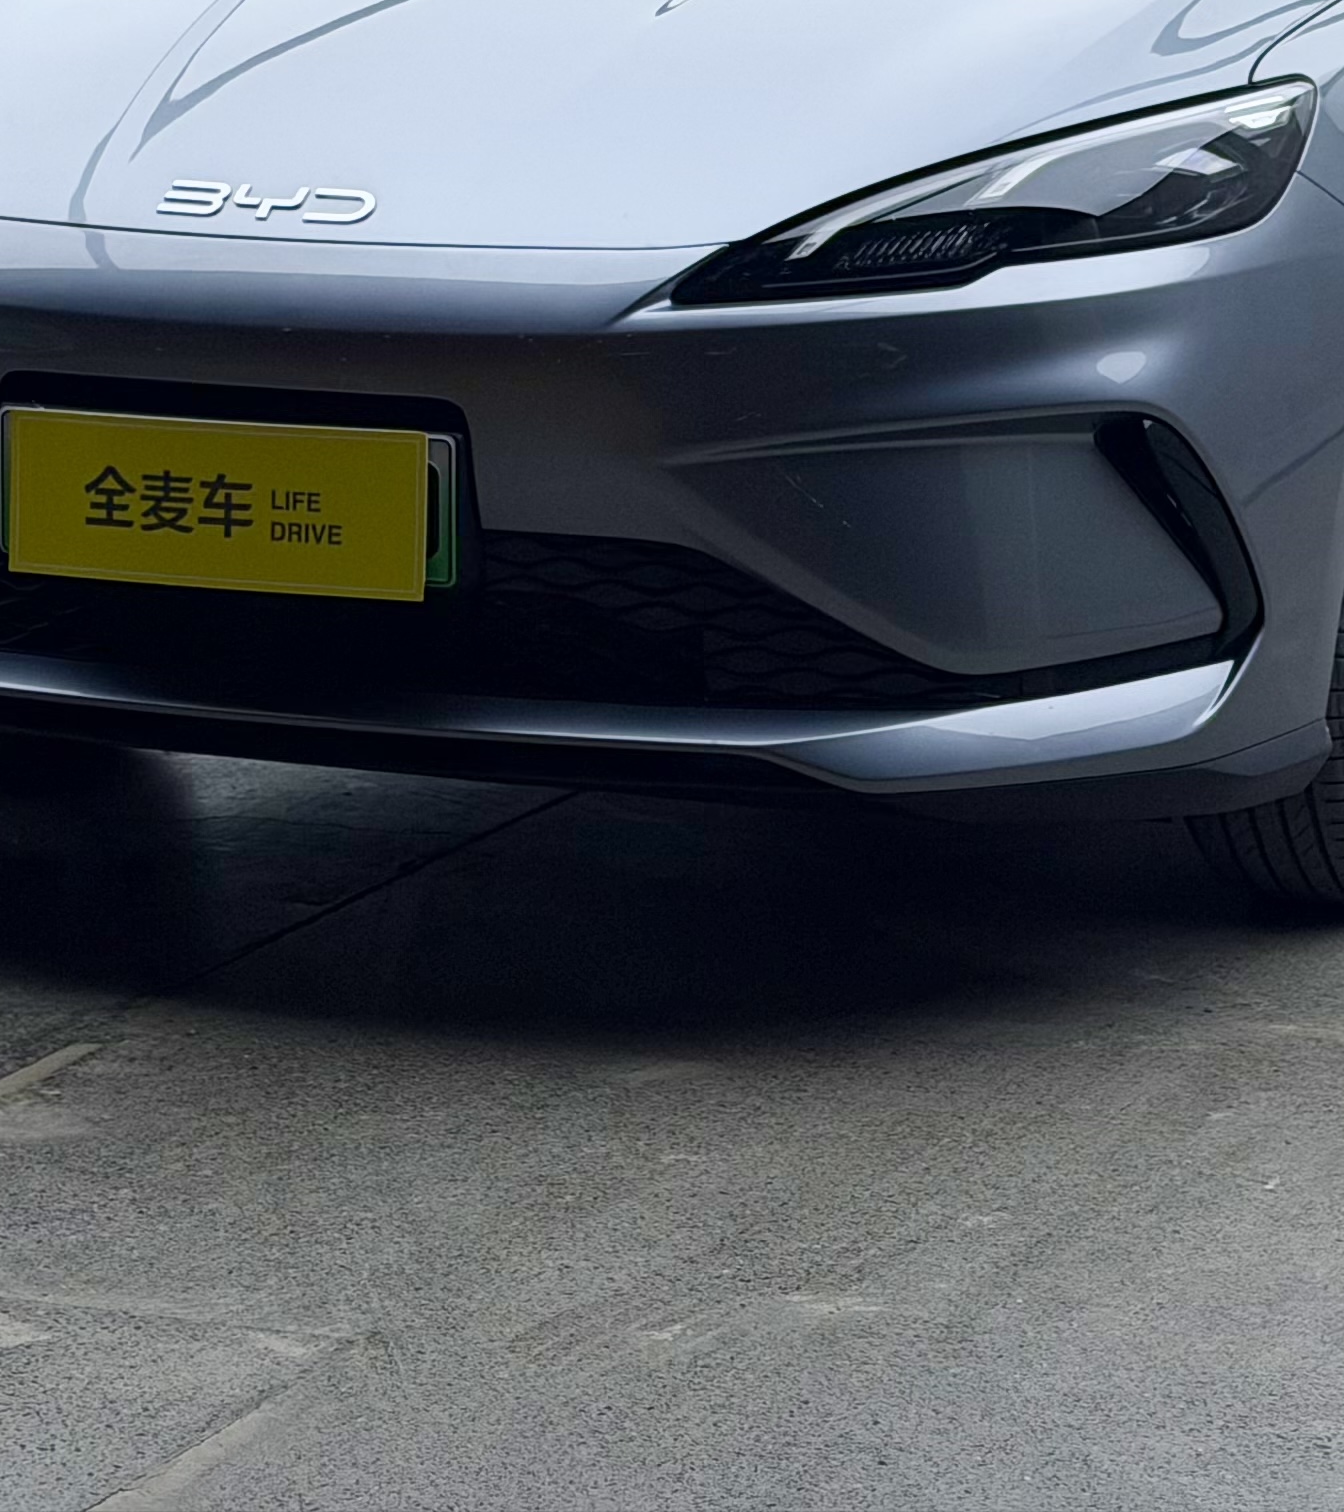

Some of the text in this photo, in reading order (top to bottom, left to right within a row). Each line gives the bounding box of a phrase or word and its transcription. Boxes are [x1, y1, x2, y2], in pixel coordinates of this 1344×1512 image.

[156, 178, 377, 226] BYD
[83, 464, 256, 539] 全麦车
[269, 488, 323, 514] LIFE
[268, 519, 344, 547] DRIVE
